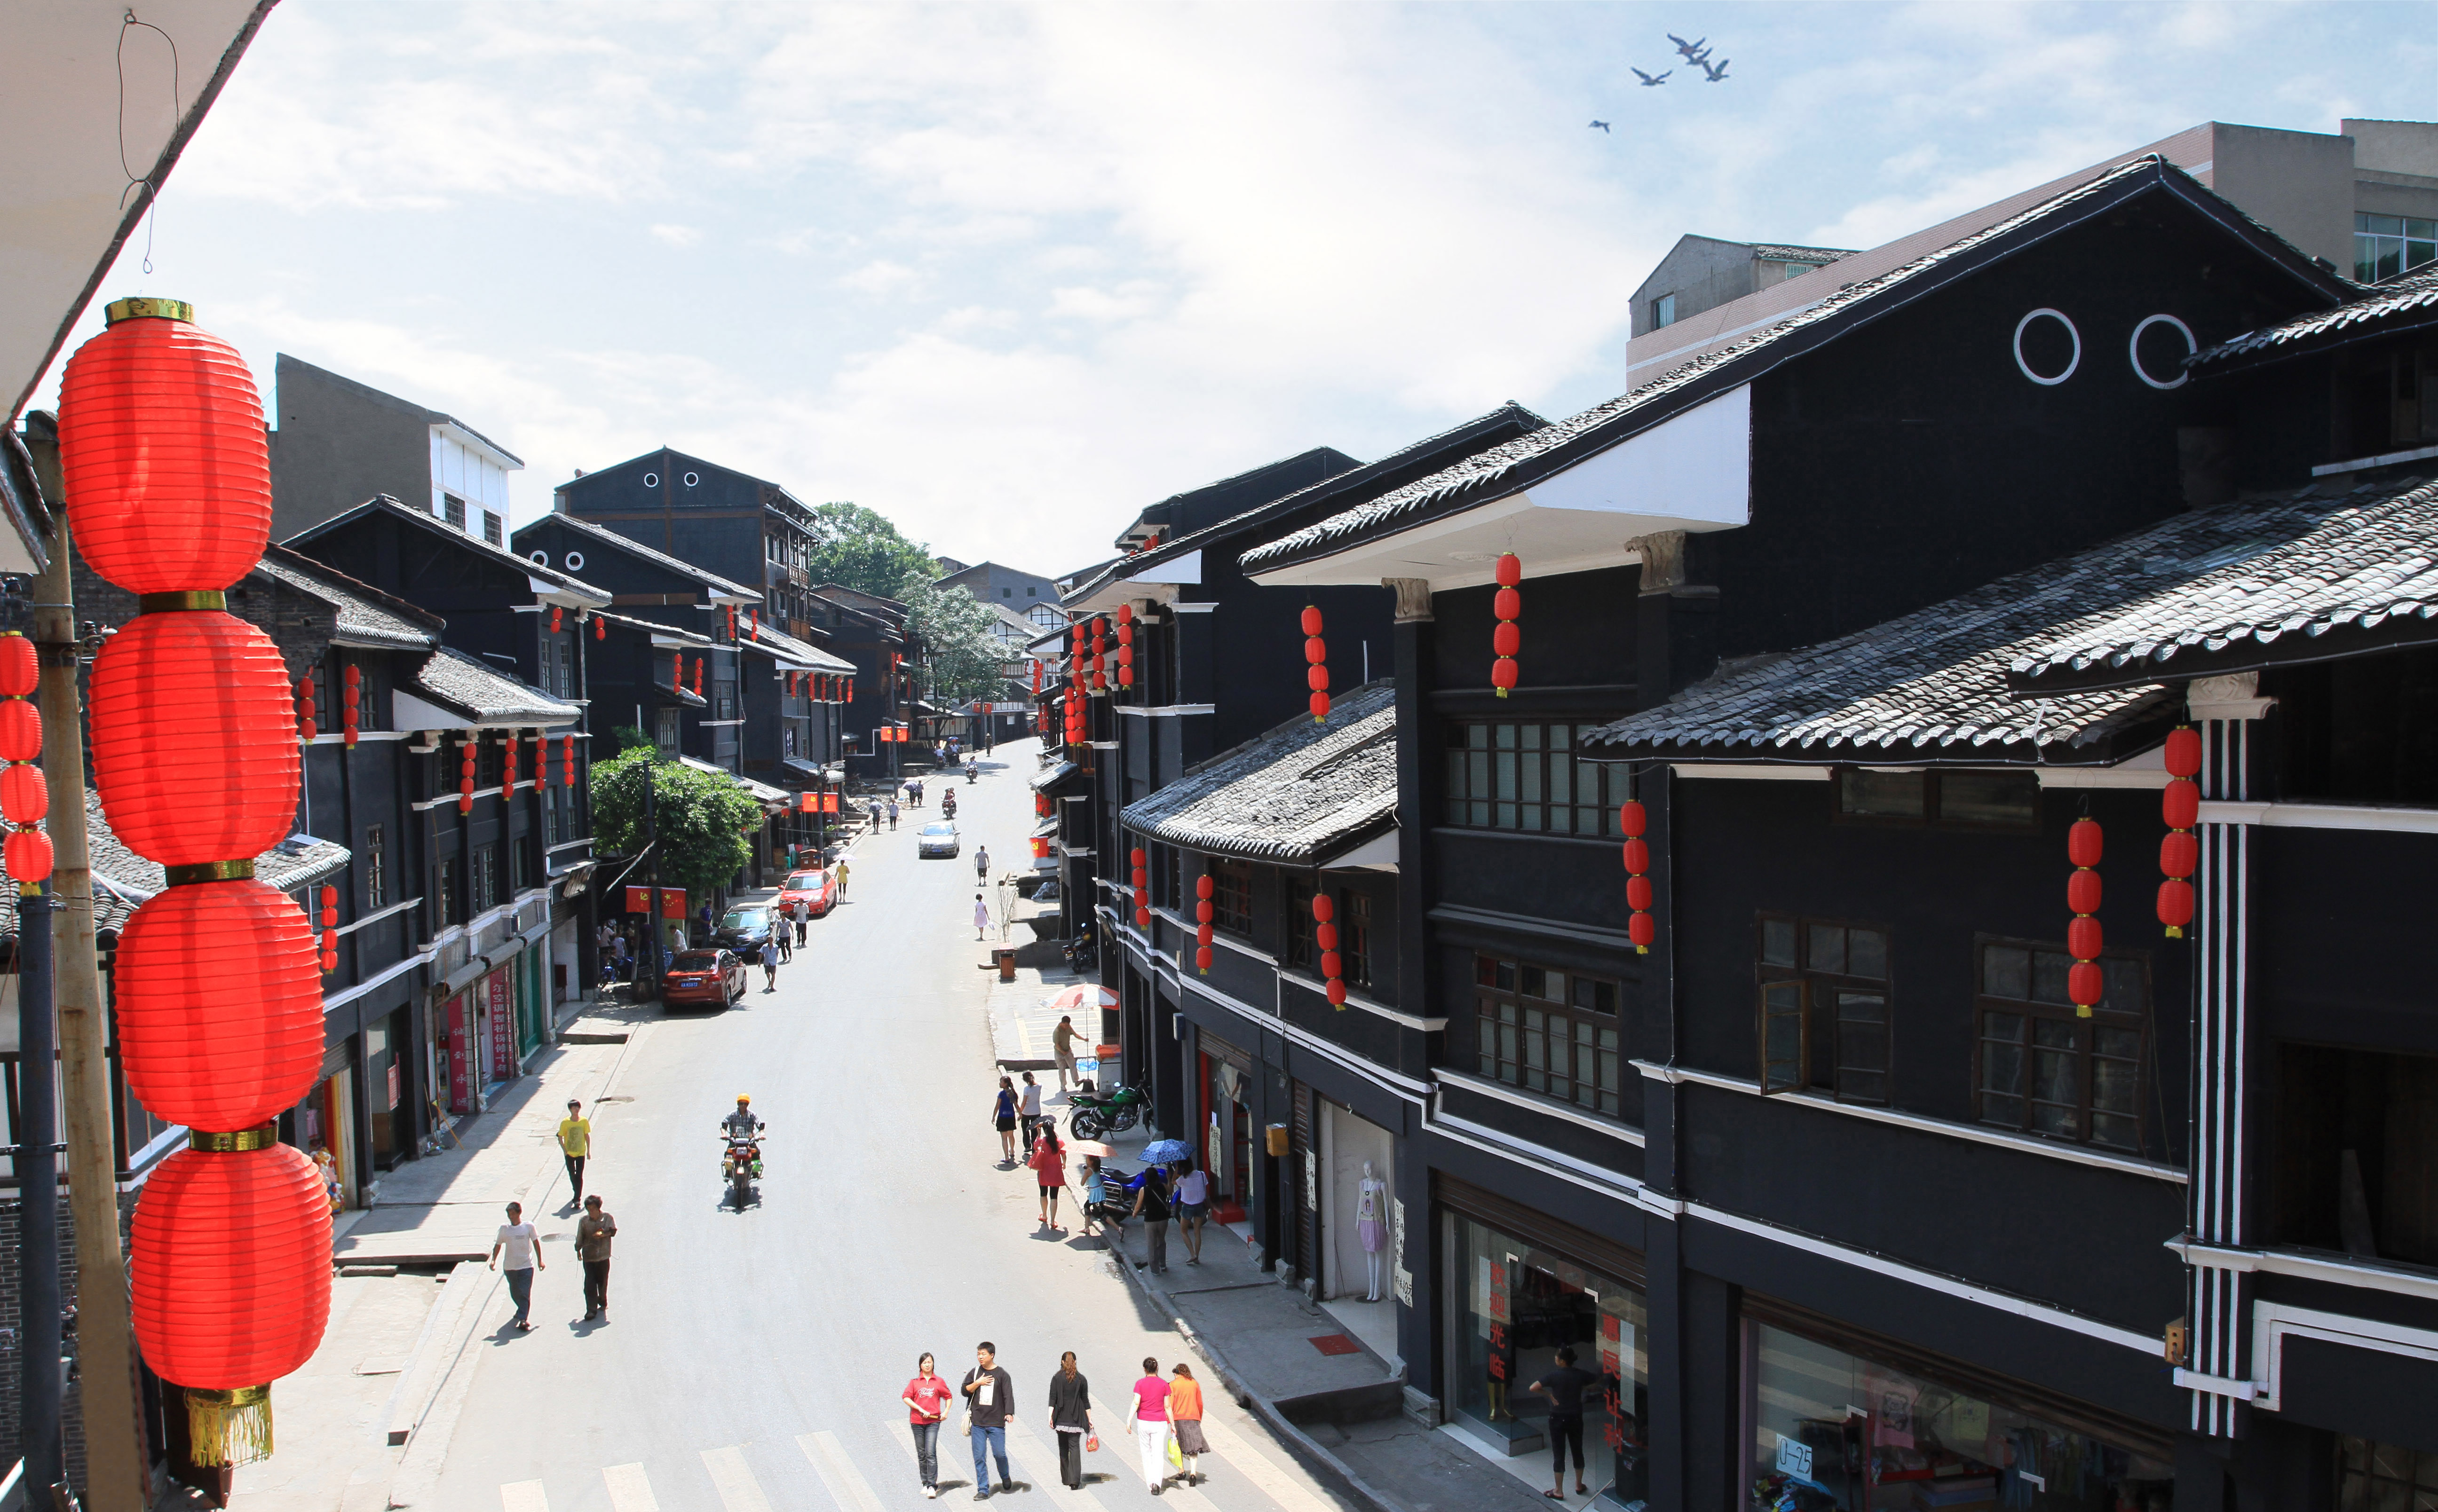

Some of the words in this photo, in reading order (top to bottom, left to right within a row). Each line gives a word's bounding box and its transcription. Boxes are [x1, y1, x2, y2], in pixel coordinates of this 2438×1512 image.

[1489, 1261, 1506, 1380] 欢迎光临
[1601, 1313, 1623, 1453] 惠民让利
[1777, 1438, 1812, 1474] 10-25
